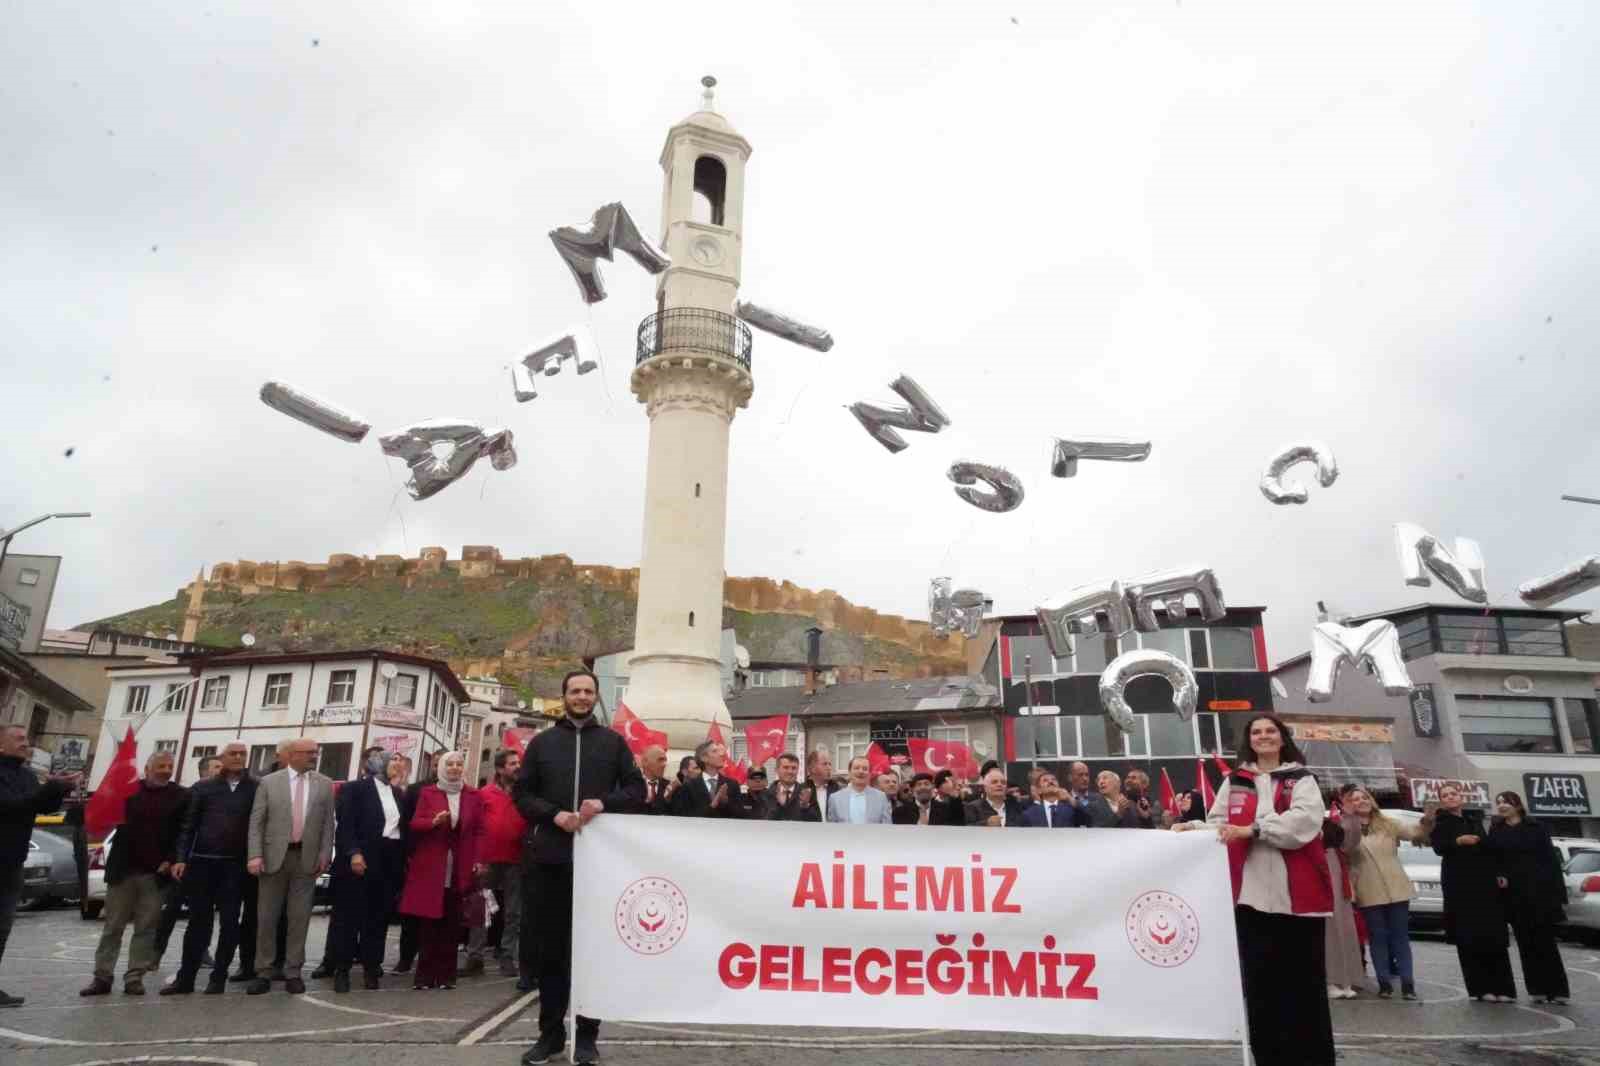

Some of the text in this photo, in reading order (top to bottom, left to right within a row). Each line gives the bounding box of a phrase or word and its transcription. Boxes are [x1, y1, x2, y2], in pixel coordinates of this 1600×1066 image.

[1530, 777, 1584, 799] ZAFER
[792, 851, 1021, 914] AİLEMİZ
[718, 932, 1098, 1002] GELECEĞİMİZ
